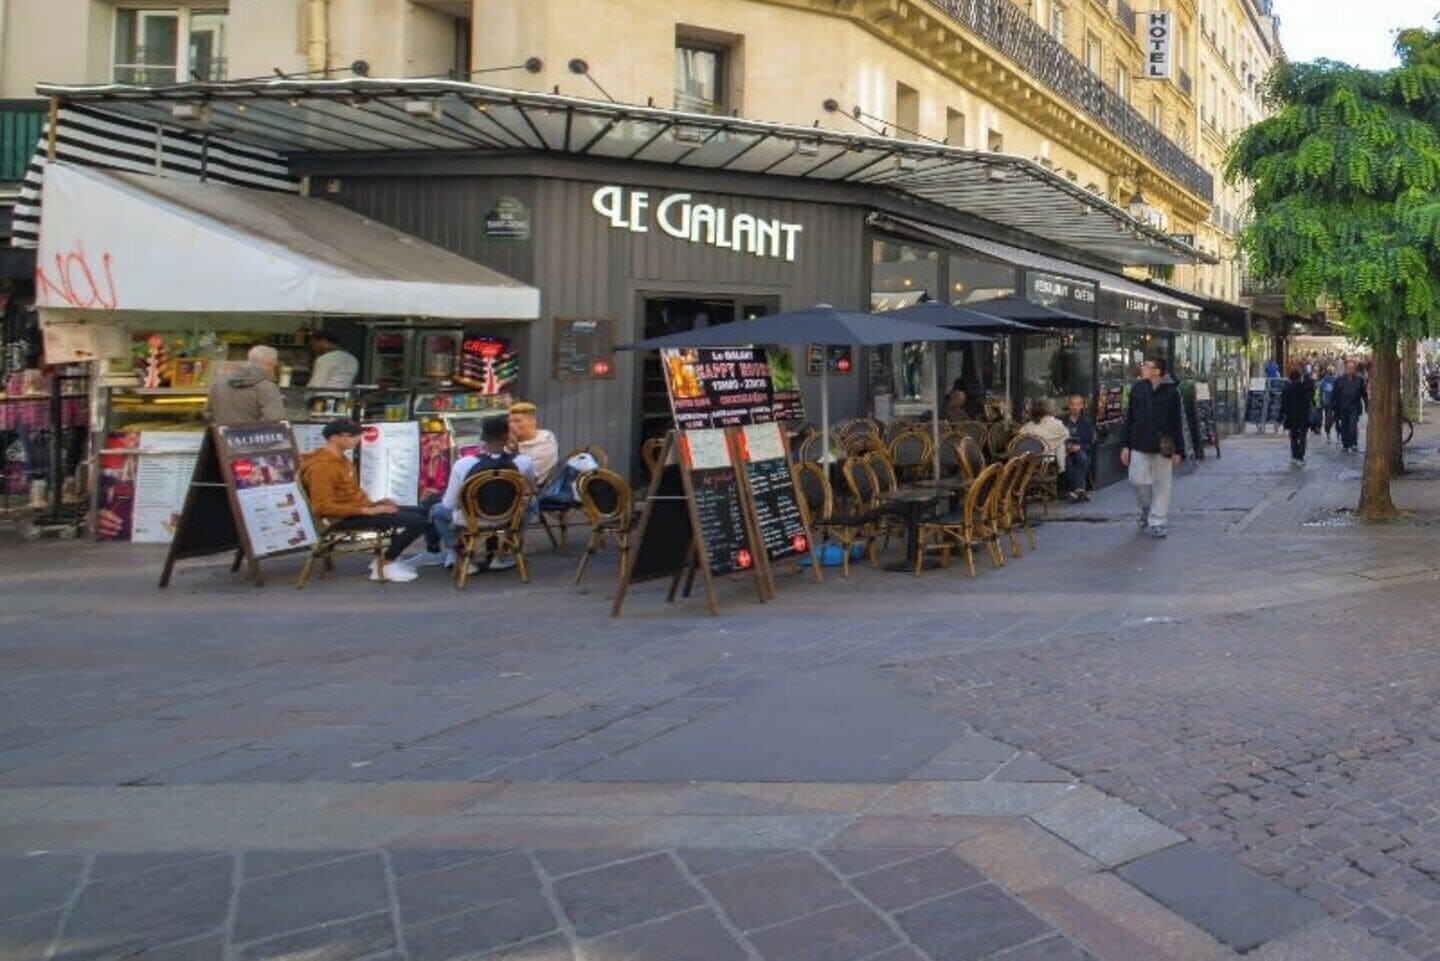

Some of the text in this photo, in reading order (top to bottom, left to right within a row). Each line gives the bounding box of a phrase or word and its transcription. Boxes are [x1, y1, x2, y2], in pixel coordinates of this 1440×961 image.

[1149, 13, 1167, 76] HOTEL
[656, 193, 804, 262] GALANT
[695, 362, 736, 380] HAPPY
